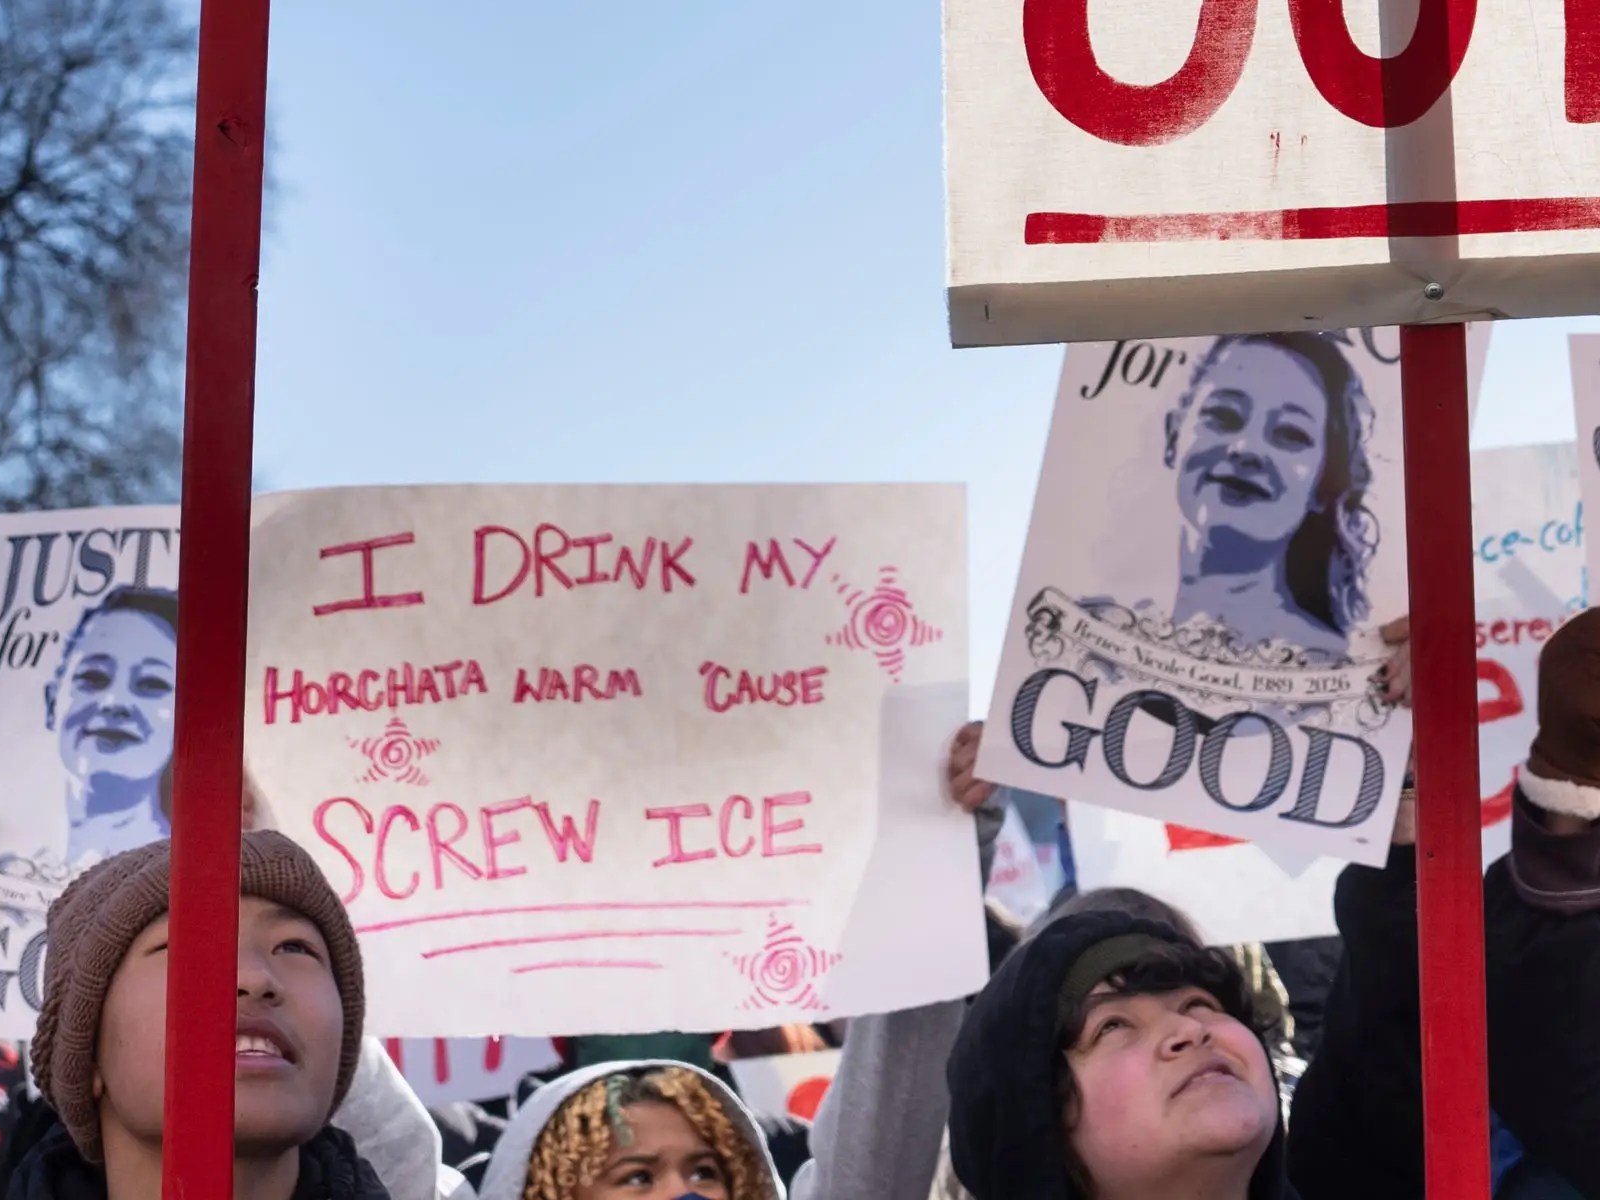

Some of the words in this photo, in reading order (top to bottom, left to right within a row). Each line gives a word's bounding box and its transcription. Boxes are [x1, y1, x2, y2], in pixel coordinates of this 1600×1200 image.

[313, 532, 425, 616] I
[472, 523, 697, 605] DRINK
[741, 536, 838, 595] MY
[264, 660, 488, 724] HORCHATA
[514, 666, 643, 704] WARM
[1011, 668, 1385, 829] GOOD
[313, 795, 601, 904] SCREW
[645, 791, 824, 868] ICE
